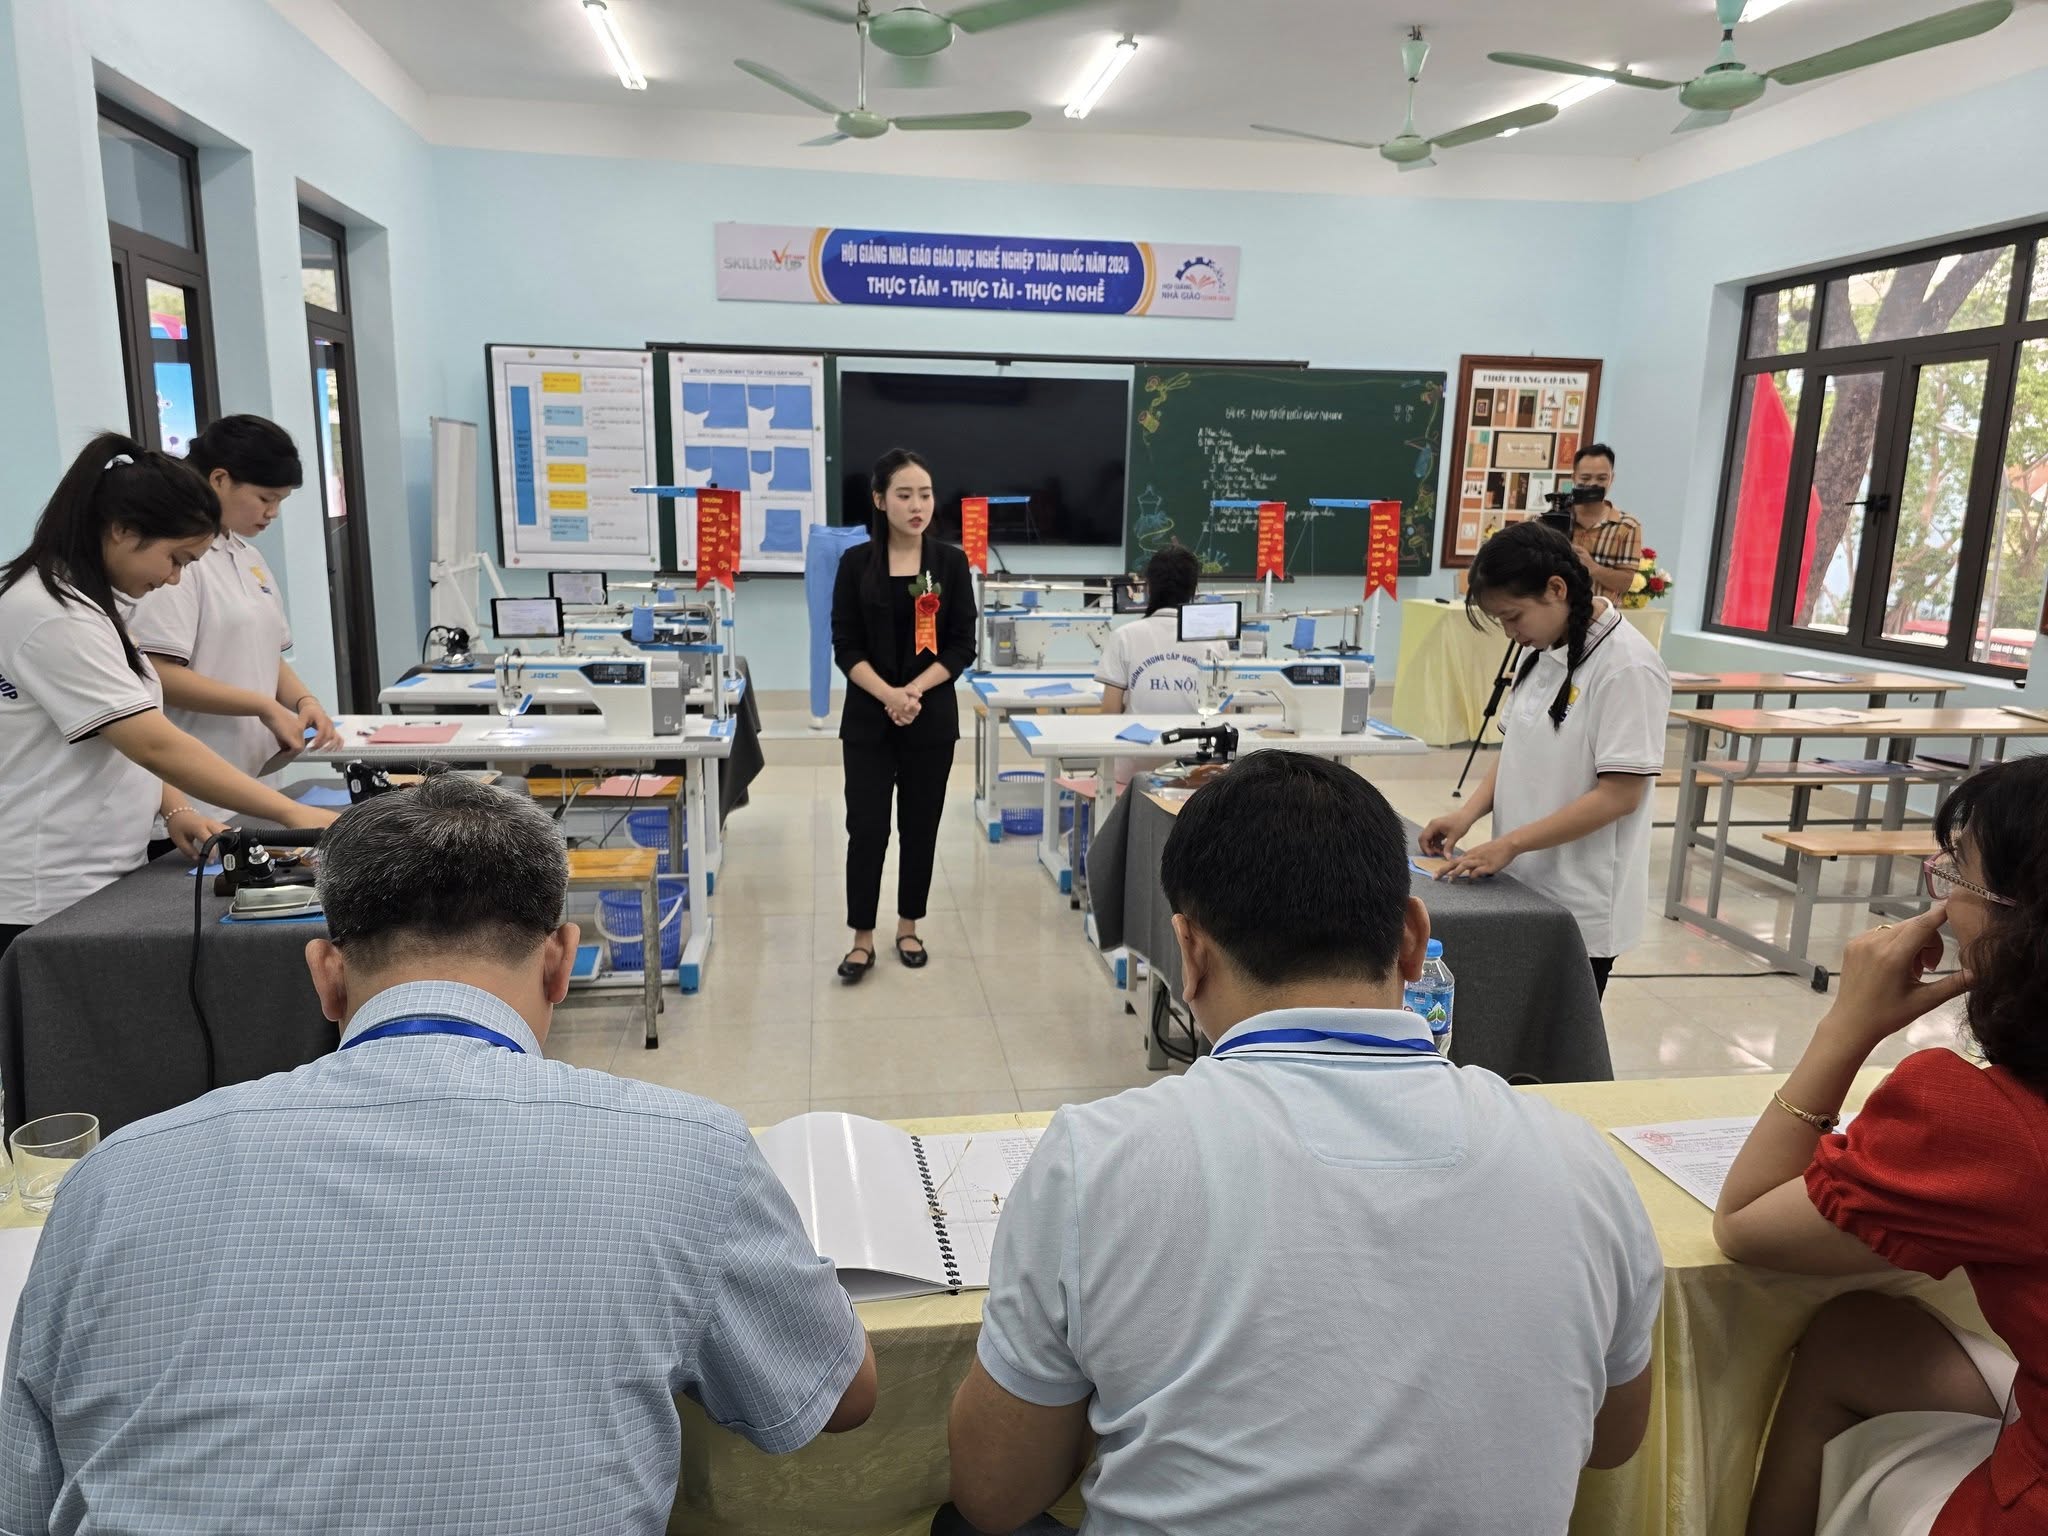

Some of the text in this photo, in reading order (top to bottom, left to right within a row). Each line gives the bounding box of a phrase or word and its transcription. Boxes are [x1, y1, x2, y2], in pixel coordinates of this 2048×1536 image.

[841, 240, 858, 266] HỘI
[859, 239, 887, 264] GIẢNG
[888, 243, 908, 265] NHÀ
[909, 243, 931, 266] GIÁO
[933, 244, 954, 267] GIÁO
[956, 249, 975, 272] DỤC
[1001, 248, 1034, 275] NGHIỆP
[1035, 249, 1058, 272] TOÀN
[1060, 248, 1084, 274] QUỐC
[1085, 251, 1106, 273] NĂM
[1107, 255, 1130, 275] 2024
[867, 275, 906, 299] THỰC
[909, 274, 940, 297] TÂM
[950, 278, 989, 303] THỰC
[992, 277, 1014, 300] TÀI
[1024, 281, 1063, 306] THỰC
[1065, 278, 1105, 303] NGHỀ
[1142, 653, 1165, 668] TRUNG
[1165, 652, 1180, 661] CẤP
[1150, 675, 1197, 694] HÀ NỘI
